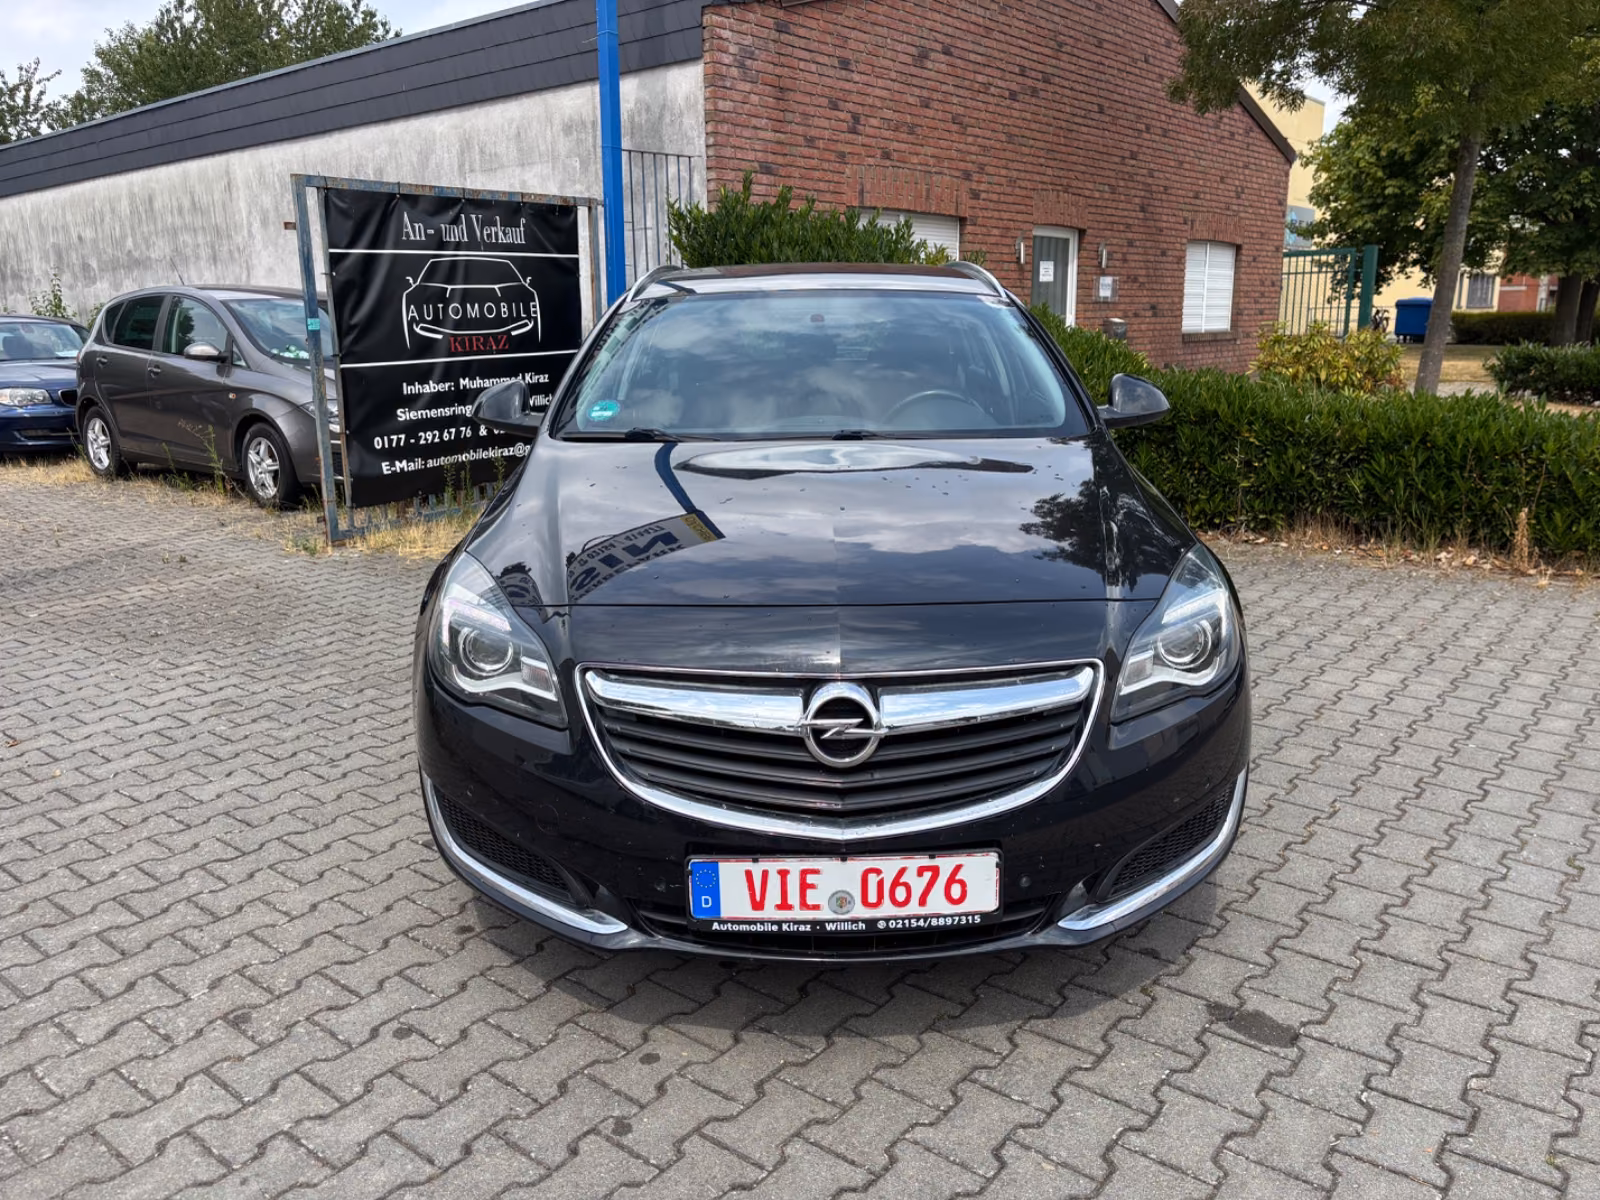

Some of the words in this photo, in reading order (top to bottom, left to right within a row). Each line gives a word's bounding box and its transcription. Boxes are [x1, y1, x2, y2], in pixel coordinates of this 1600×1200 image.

[402, 211, 434, 241] An-
[440, 213, 469, 242] und
[470, 214, 526, 244] Verkauf
[408, 302, 538, 321] AUTOMOBILE
[450, 335, 509, 352] KIRAZ
[402, 380, 455, 395] Inhaber:
[524, 372, 549, 384] Kiraz
[396, 402, 472, 421] Siemensring
[373, 434, 406, 450] 0177
[418, 430, 440, 445] 292
[443, 428, 456, 441] 67
[460, 426, 472, 439] 76
[479, 424, 488, 436] &
[381, 457, 425, 475] E-Mail:
[744, 868, 823, 911] VIE
[860, 864, 968, 910] 0676
[701, 896, 712, 908] D
[712, 922, 779, 932] Automobile
[782, 922, 812, 932] Kiraz
[825, 921, 866, 931] Willich
[888, 915, 982, 929] 02154/8897315
